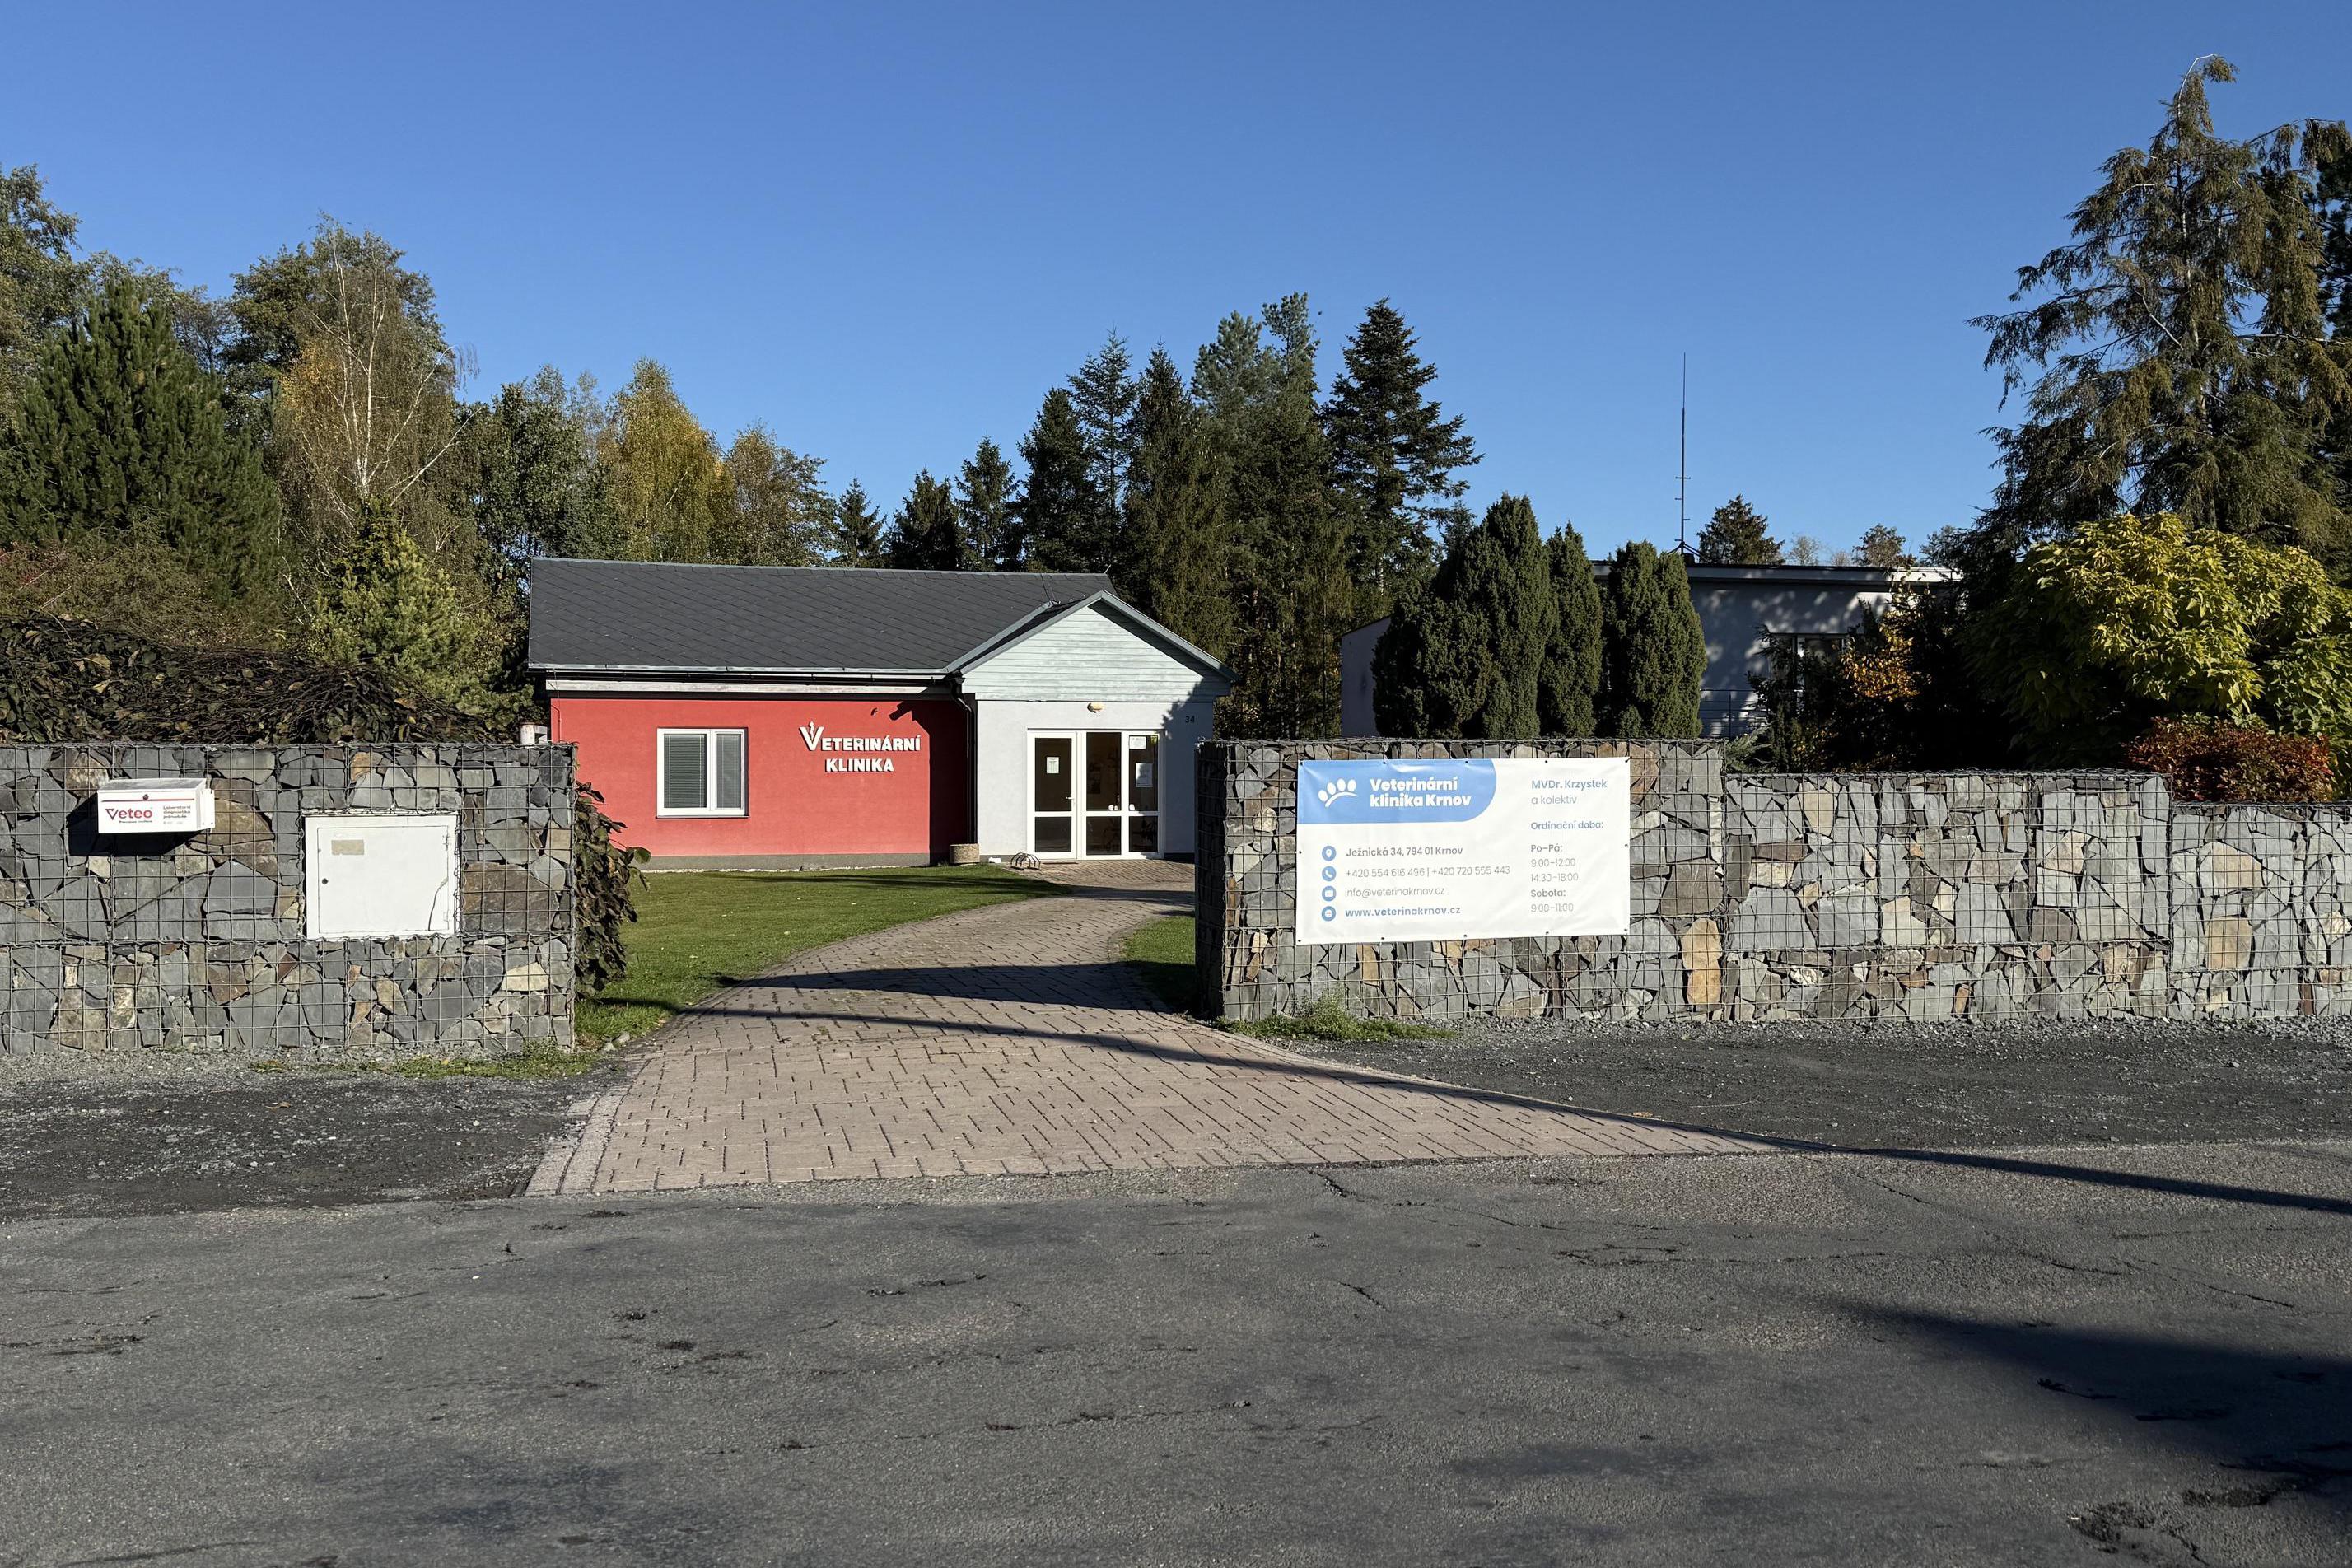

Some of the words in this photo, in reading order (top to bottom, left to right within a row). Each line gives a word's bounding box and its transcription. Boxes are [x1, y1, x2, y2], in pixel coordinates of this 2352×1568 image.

[1185, 715, 1195, 723] 34
[824, 758, 894, 772] KLINIKA
[1370, 776, 1458, 791] Veterinární
[1531, 780, 1563, 789] MVDr.
[1565, 779, 1608, 791] Krzystek
[1370, 793, 1424, 807] klinika
[1425, 794, 1472, 806] Krnov
[1531, 796, 1538, 805] a
[1541, 795, 1577, 805] kolektiv
[105, 808, 153, 820] Veteo
[1530, 820, 1576, 830] Ordinační
[1578, 821, 1604, 829] doba:
[1346, 847, 1388, 857] Ježnická
[1390, 847, 1405, 856] 34,
[1406, 847, 1423, 856] 794
[1435, 847, 1463, 856] Krnov
[1346, 869, 1370, 878] +420
[1371, 869, 1389, 877] 554
[1431, 867, 1455, 876] +420
[1457, 866, 1472, 875] 720
[1475, 866, 1492, 875] 555
[1494, 866, 1511, 875] 443
[1345, 887, 1445, 898] info@veterinakrnov.cz
[1530, 889, 1566, 898] Sobota:
[1345, 907, 1461, 917] www.veterinakrnov.cz
